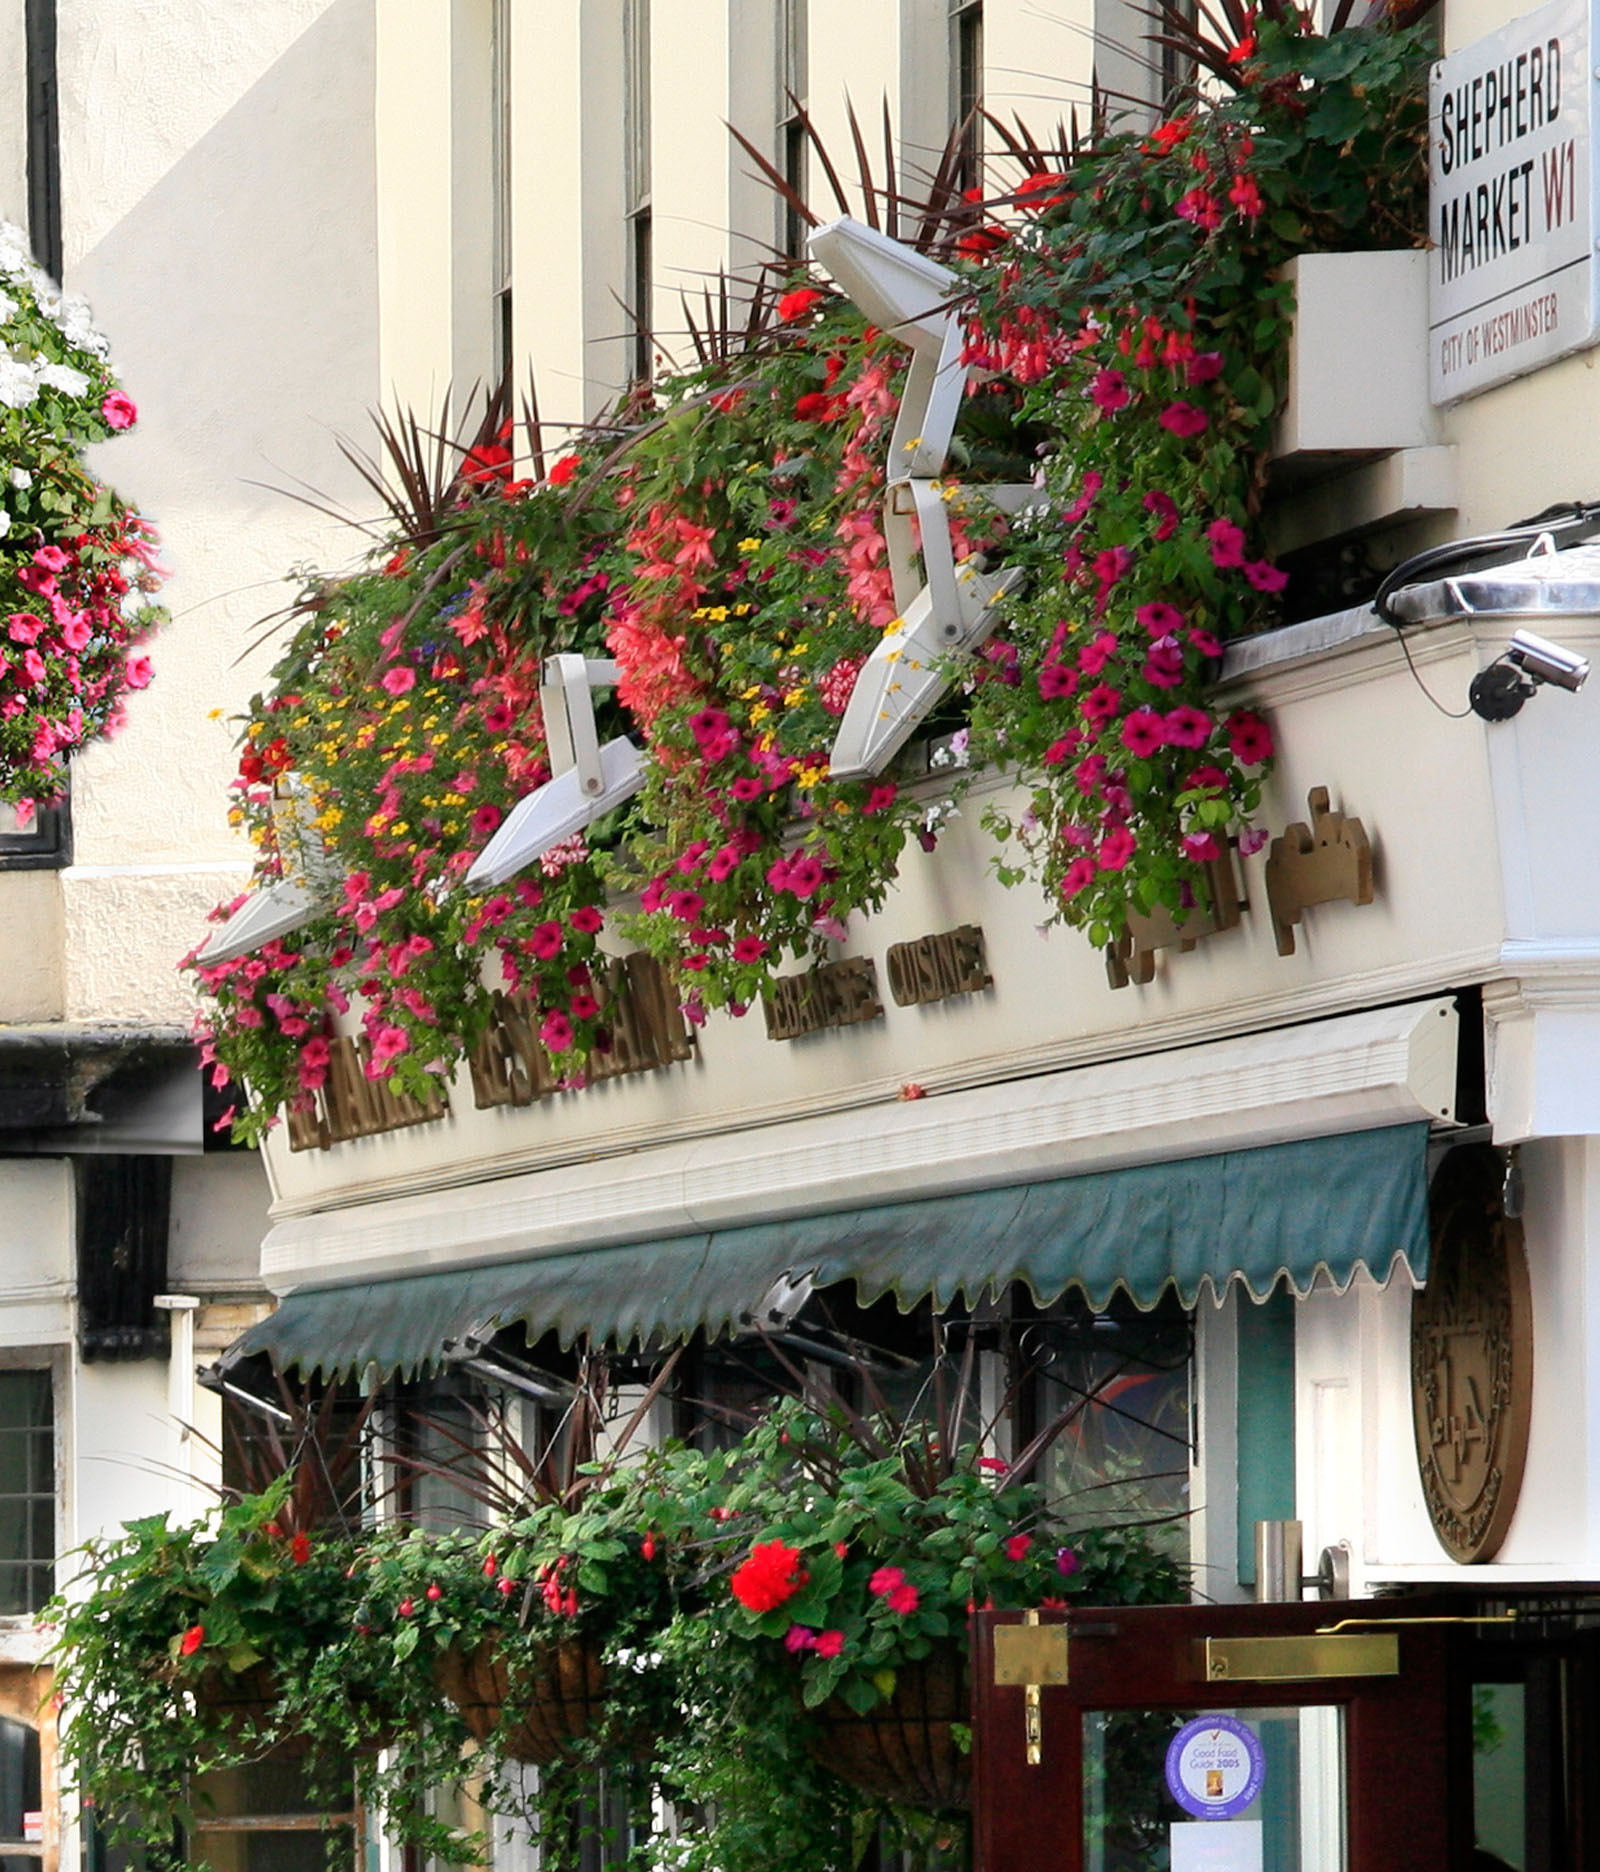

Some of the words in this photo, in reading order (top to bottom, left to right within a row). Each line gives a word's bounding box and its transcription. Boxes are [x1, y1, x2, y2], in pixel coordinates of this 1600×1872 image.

[1441, 37, 1561, 175] SHEPHERD
[1441, 160, 1534, 285] MARKET
[1542, 139, 1575, 233] W1
[1442, 332, 1463, 375] CITY
[1467, 325, 1479, 365] OF
[1482, 292, 1558, 358] WESTMINSTER
